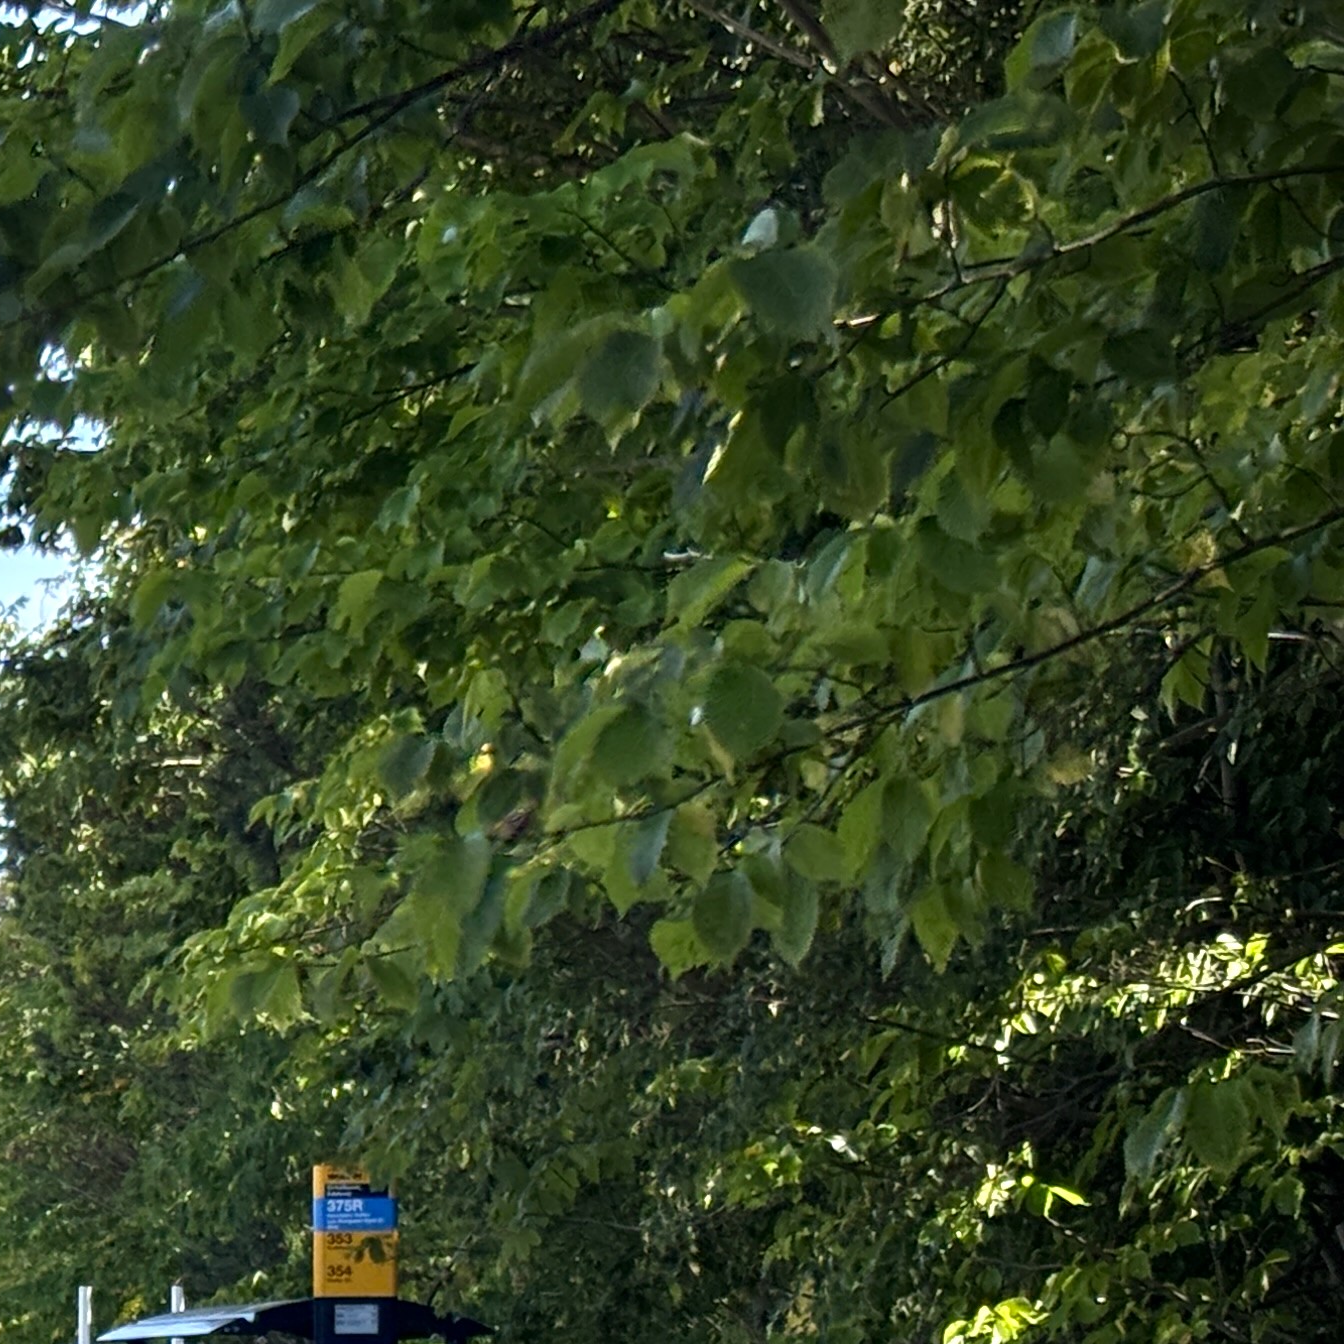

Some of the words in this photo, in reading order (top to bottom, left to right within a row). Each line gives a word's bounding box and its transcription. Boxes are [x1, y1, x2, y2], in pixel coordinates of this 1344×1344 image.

[327, 1199, 363, 1212] 375R
[327, 1233, 352, 1245] 353
[327, 1265, 352, 1277] 354
